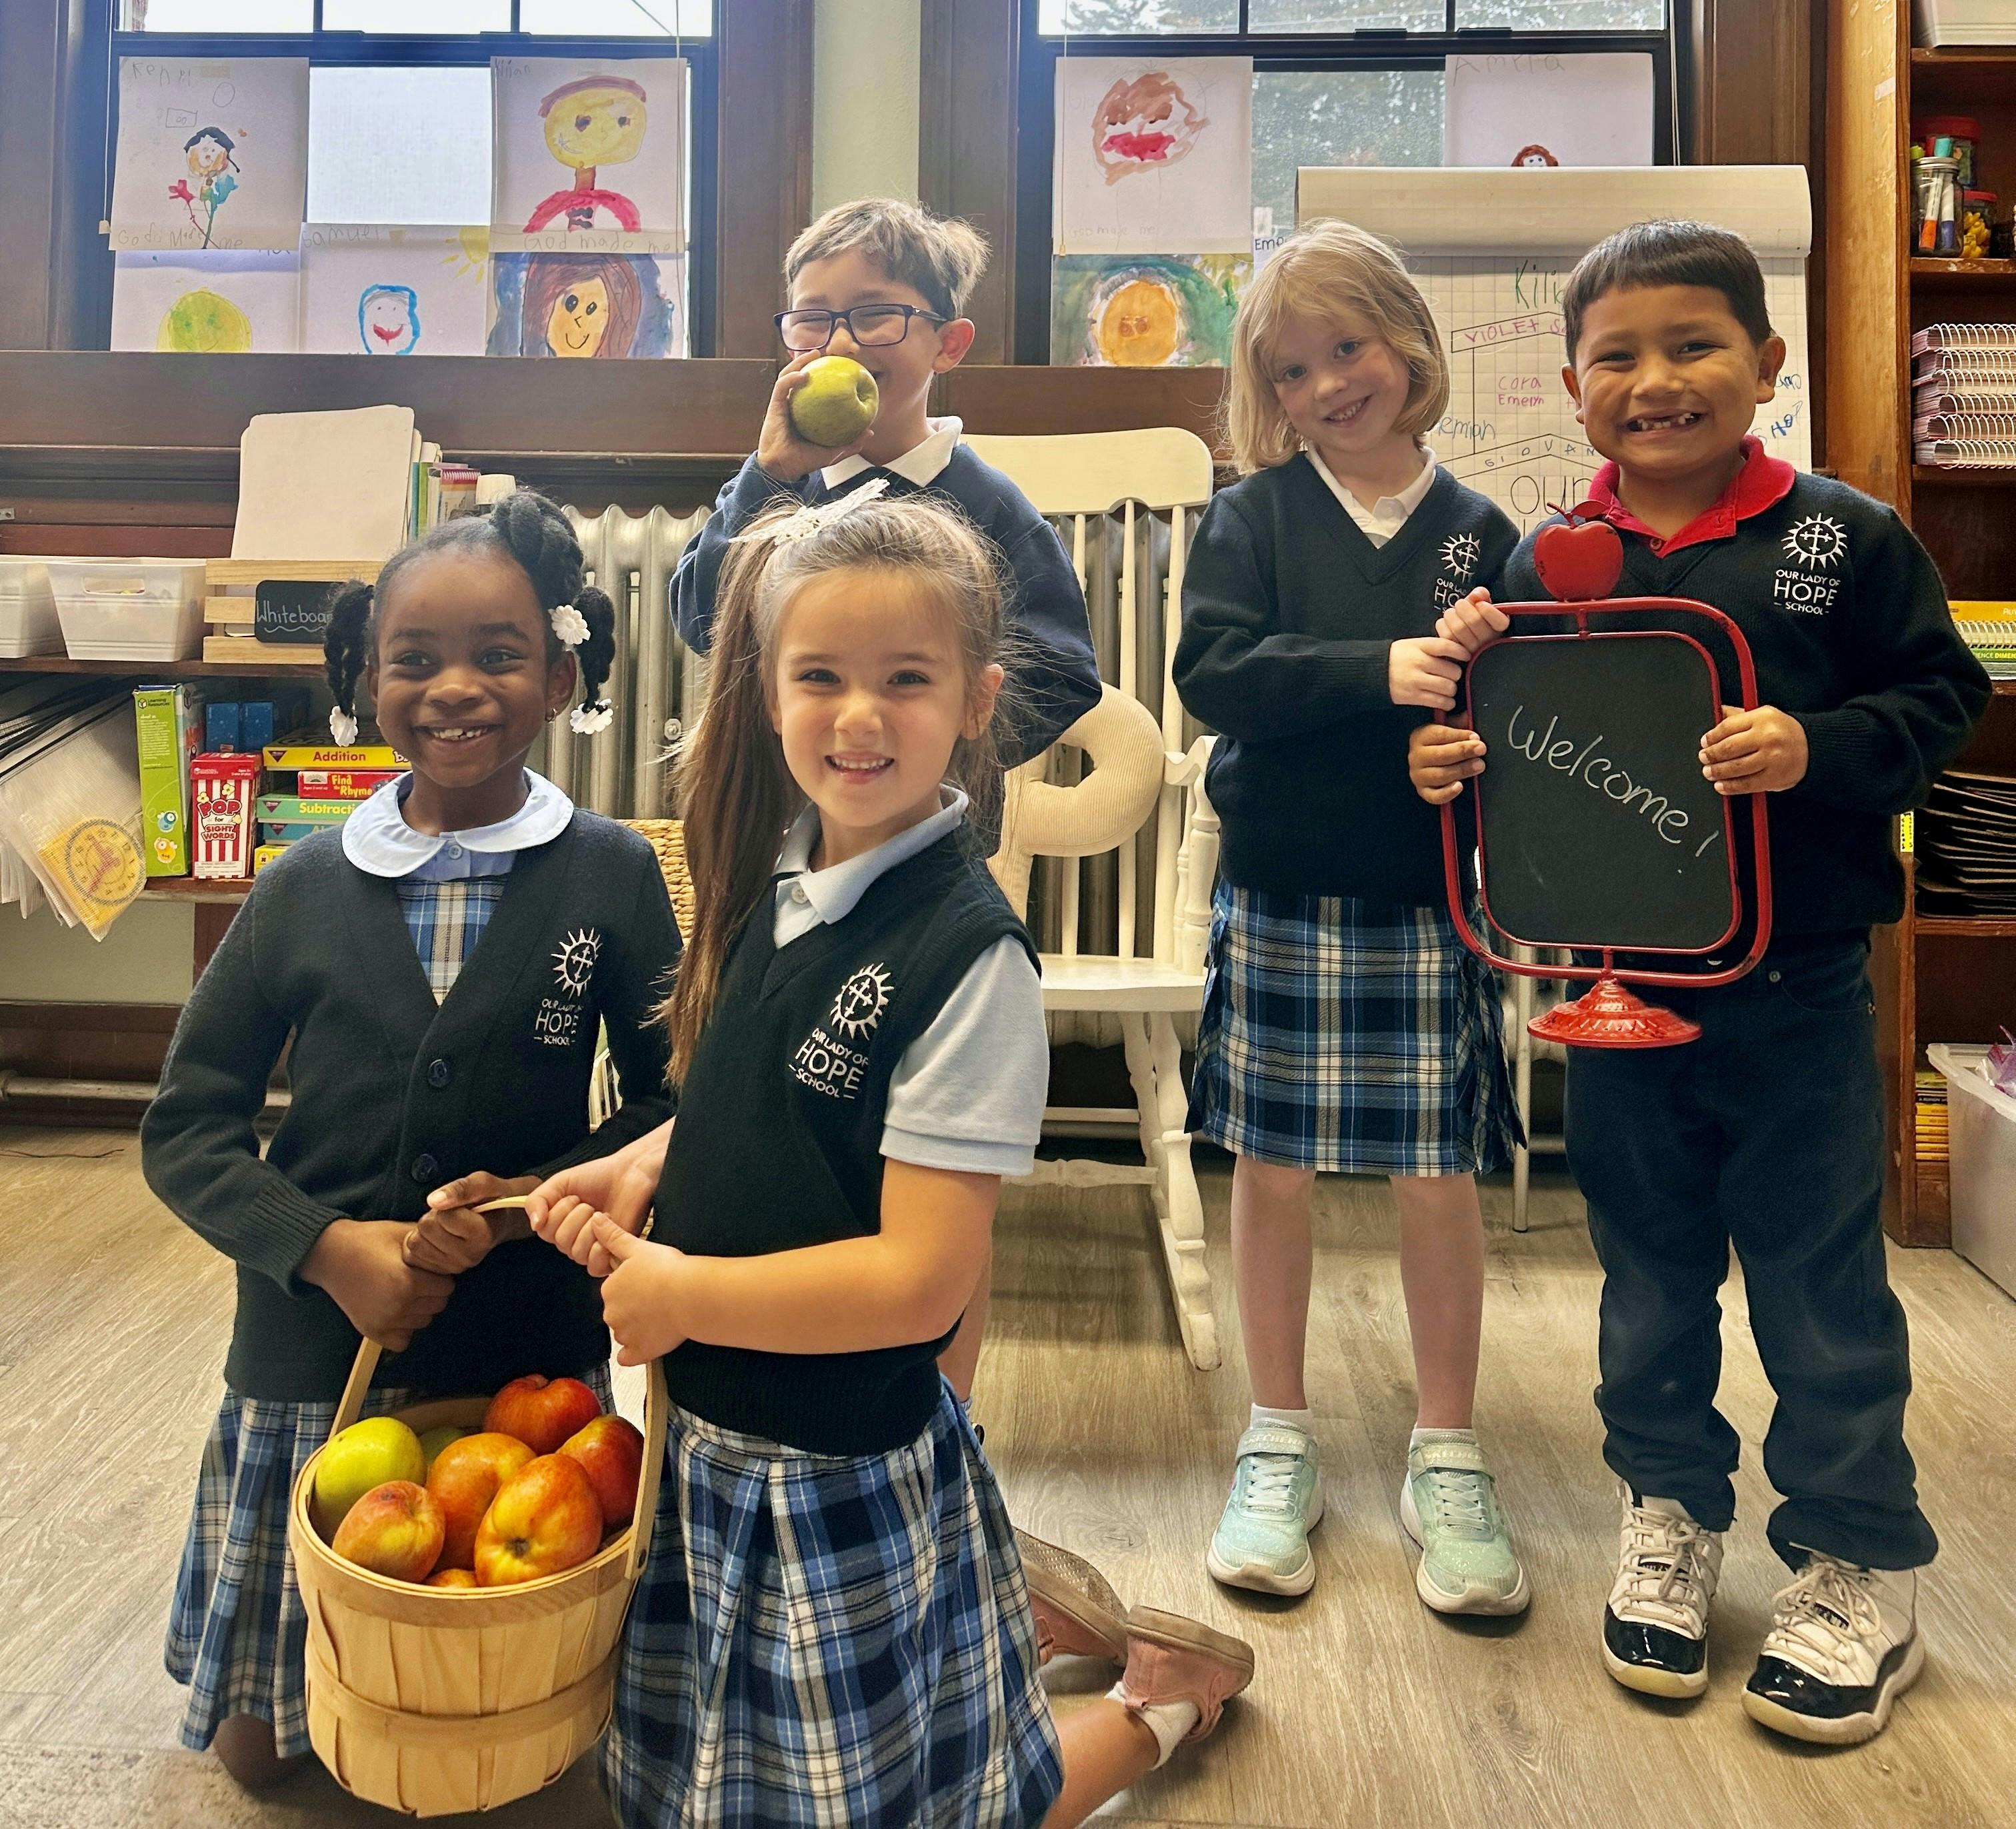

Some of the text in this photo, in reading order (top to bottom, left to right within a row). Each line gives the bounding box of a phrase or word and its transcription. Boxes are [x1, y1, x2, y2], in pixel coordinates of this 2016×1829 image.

[524, 231, 671, 253] God made me
[1498, 376, 1541, 391] Cora
[1437, 578, 1454, 589] OUR
[1775, 569, 1799, 580] OUR
[1800, 573, 1828, 585] LADY
[1774, 579, 1838, 606] HOPE
[1785, 601, 1823, 615] SCHOOL
[313, 751, 366, 762] Addition
[331, 775, 352, 785] Find
[340, 785, 373, 798] Rhyme
[197, 799, 241, 818] POP
[299, 802, 355, 815] Subtracti
[535, 1010, 579, 1034] HOPE
[824, 1037, 853, 1059] LADY
[852, 1054, 869, 1066] OF
[795, 1038, 865, 1090] HOPE
[795, 1068, 840, 1098] SCHOOL
